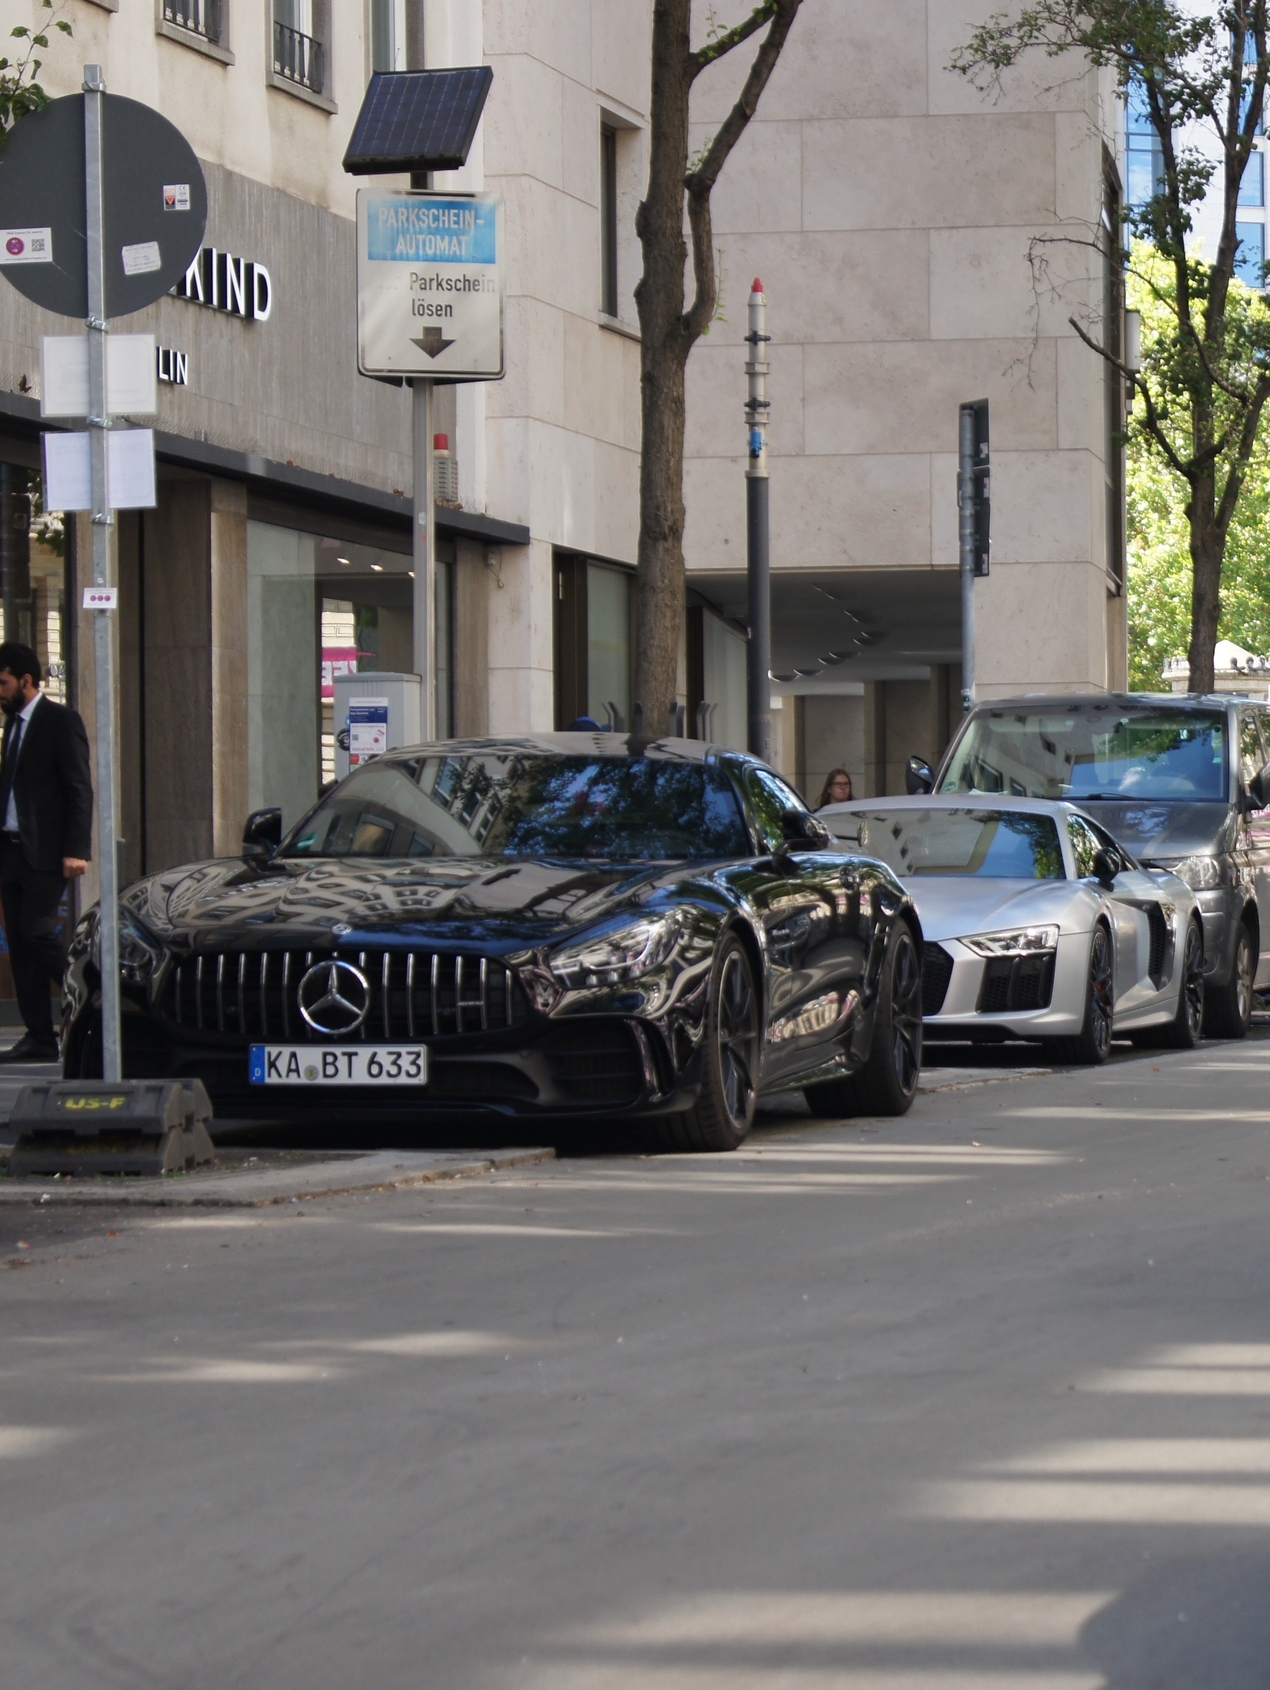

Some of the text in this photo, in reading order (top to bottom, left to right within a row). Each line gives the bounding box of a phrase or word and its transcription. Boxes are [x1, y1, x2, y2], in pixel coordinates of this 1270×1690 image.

[379, 207, 484, 229] PARKSCHEIN-
[396, 235, 468, 255] AUTOMAT
[170, 247, 271, 321] KIND
[410, 272, 495, 292] Parkschein
[412, 298, 453, 317] lösen
[254, 1068, 261, 1077] D
[267, 1051, 422, 1078] KA BT 633
